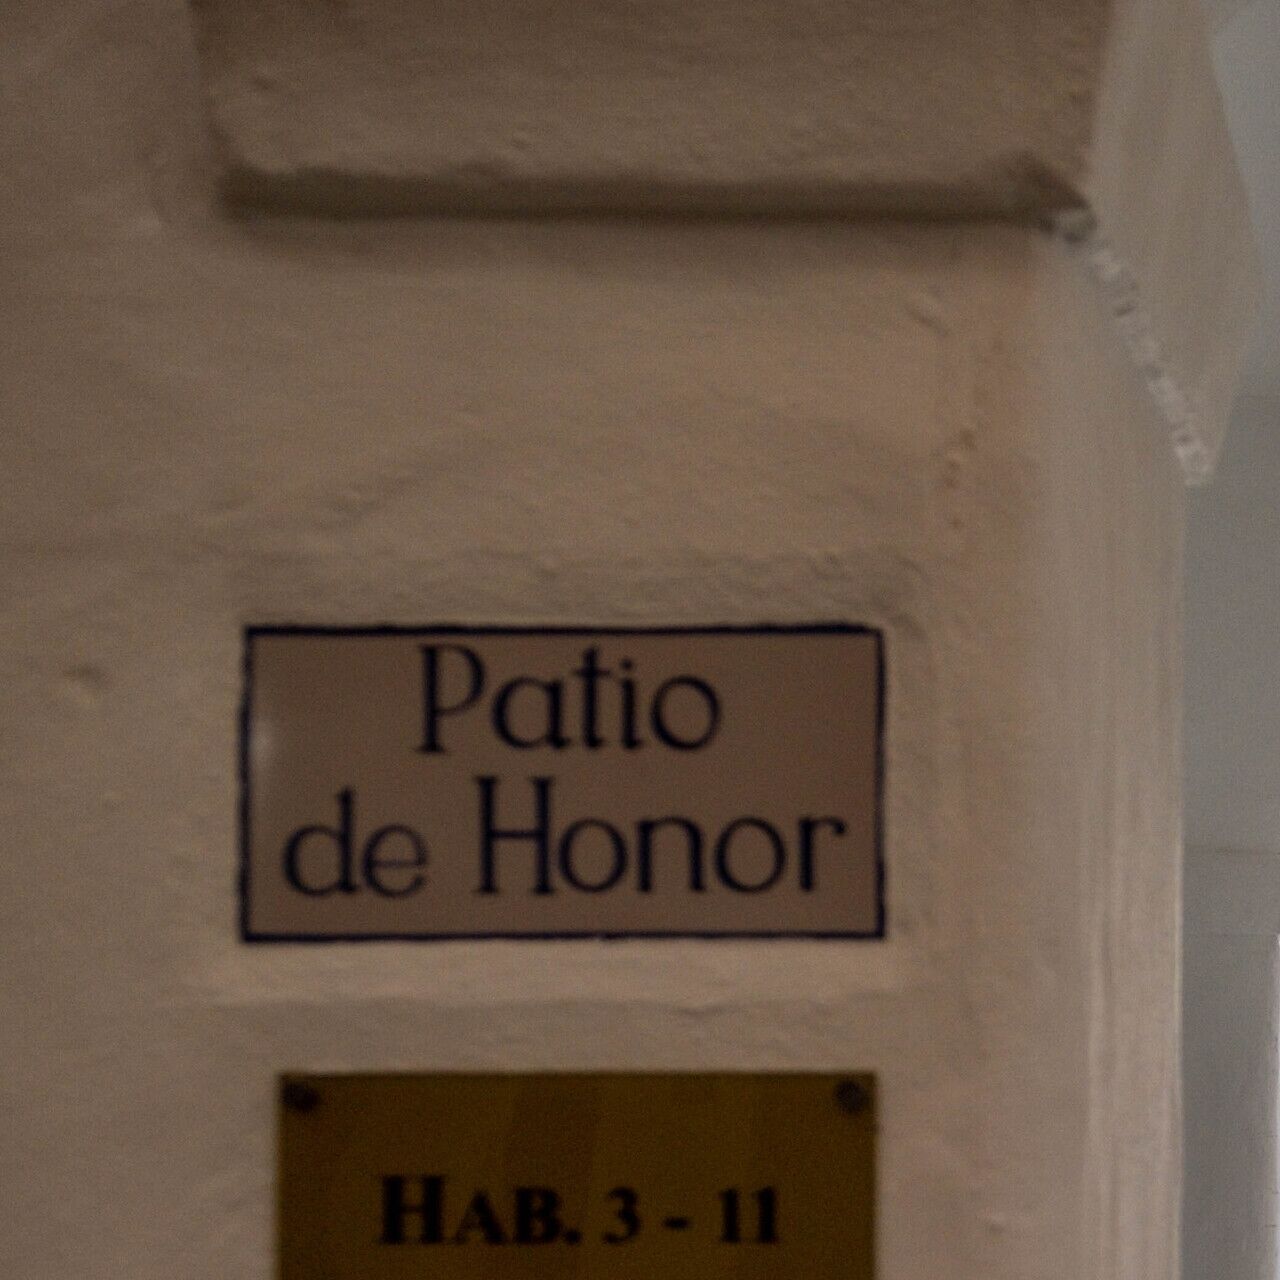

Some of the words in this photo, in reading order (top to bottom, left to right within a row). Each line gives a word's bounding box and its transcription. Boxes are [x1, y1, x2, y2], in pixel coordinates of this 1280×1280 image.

[418, 644, 722, 753] Patio
[283, 788, 429, 897] de
[474, 775, 847, 896] Honor
[603, 1187, 642, 1246] 3
[717, 1186, 780, 1246] 11
